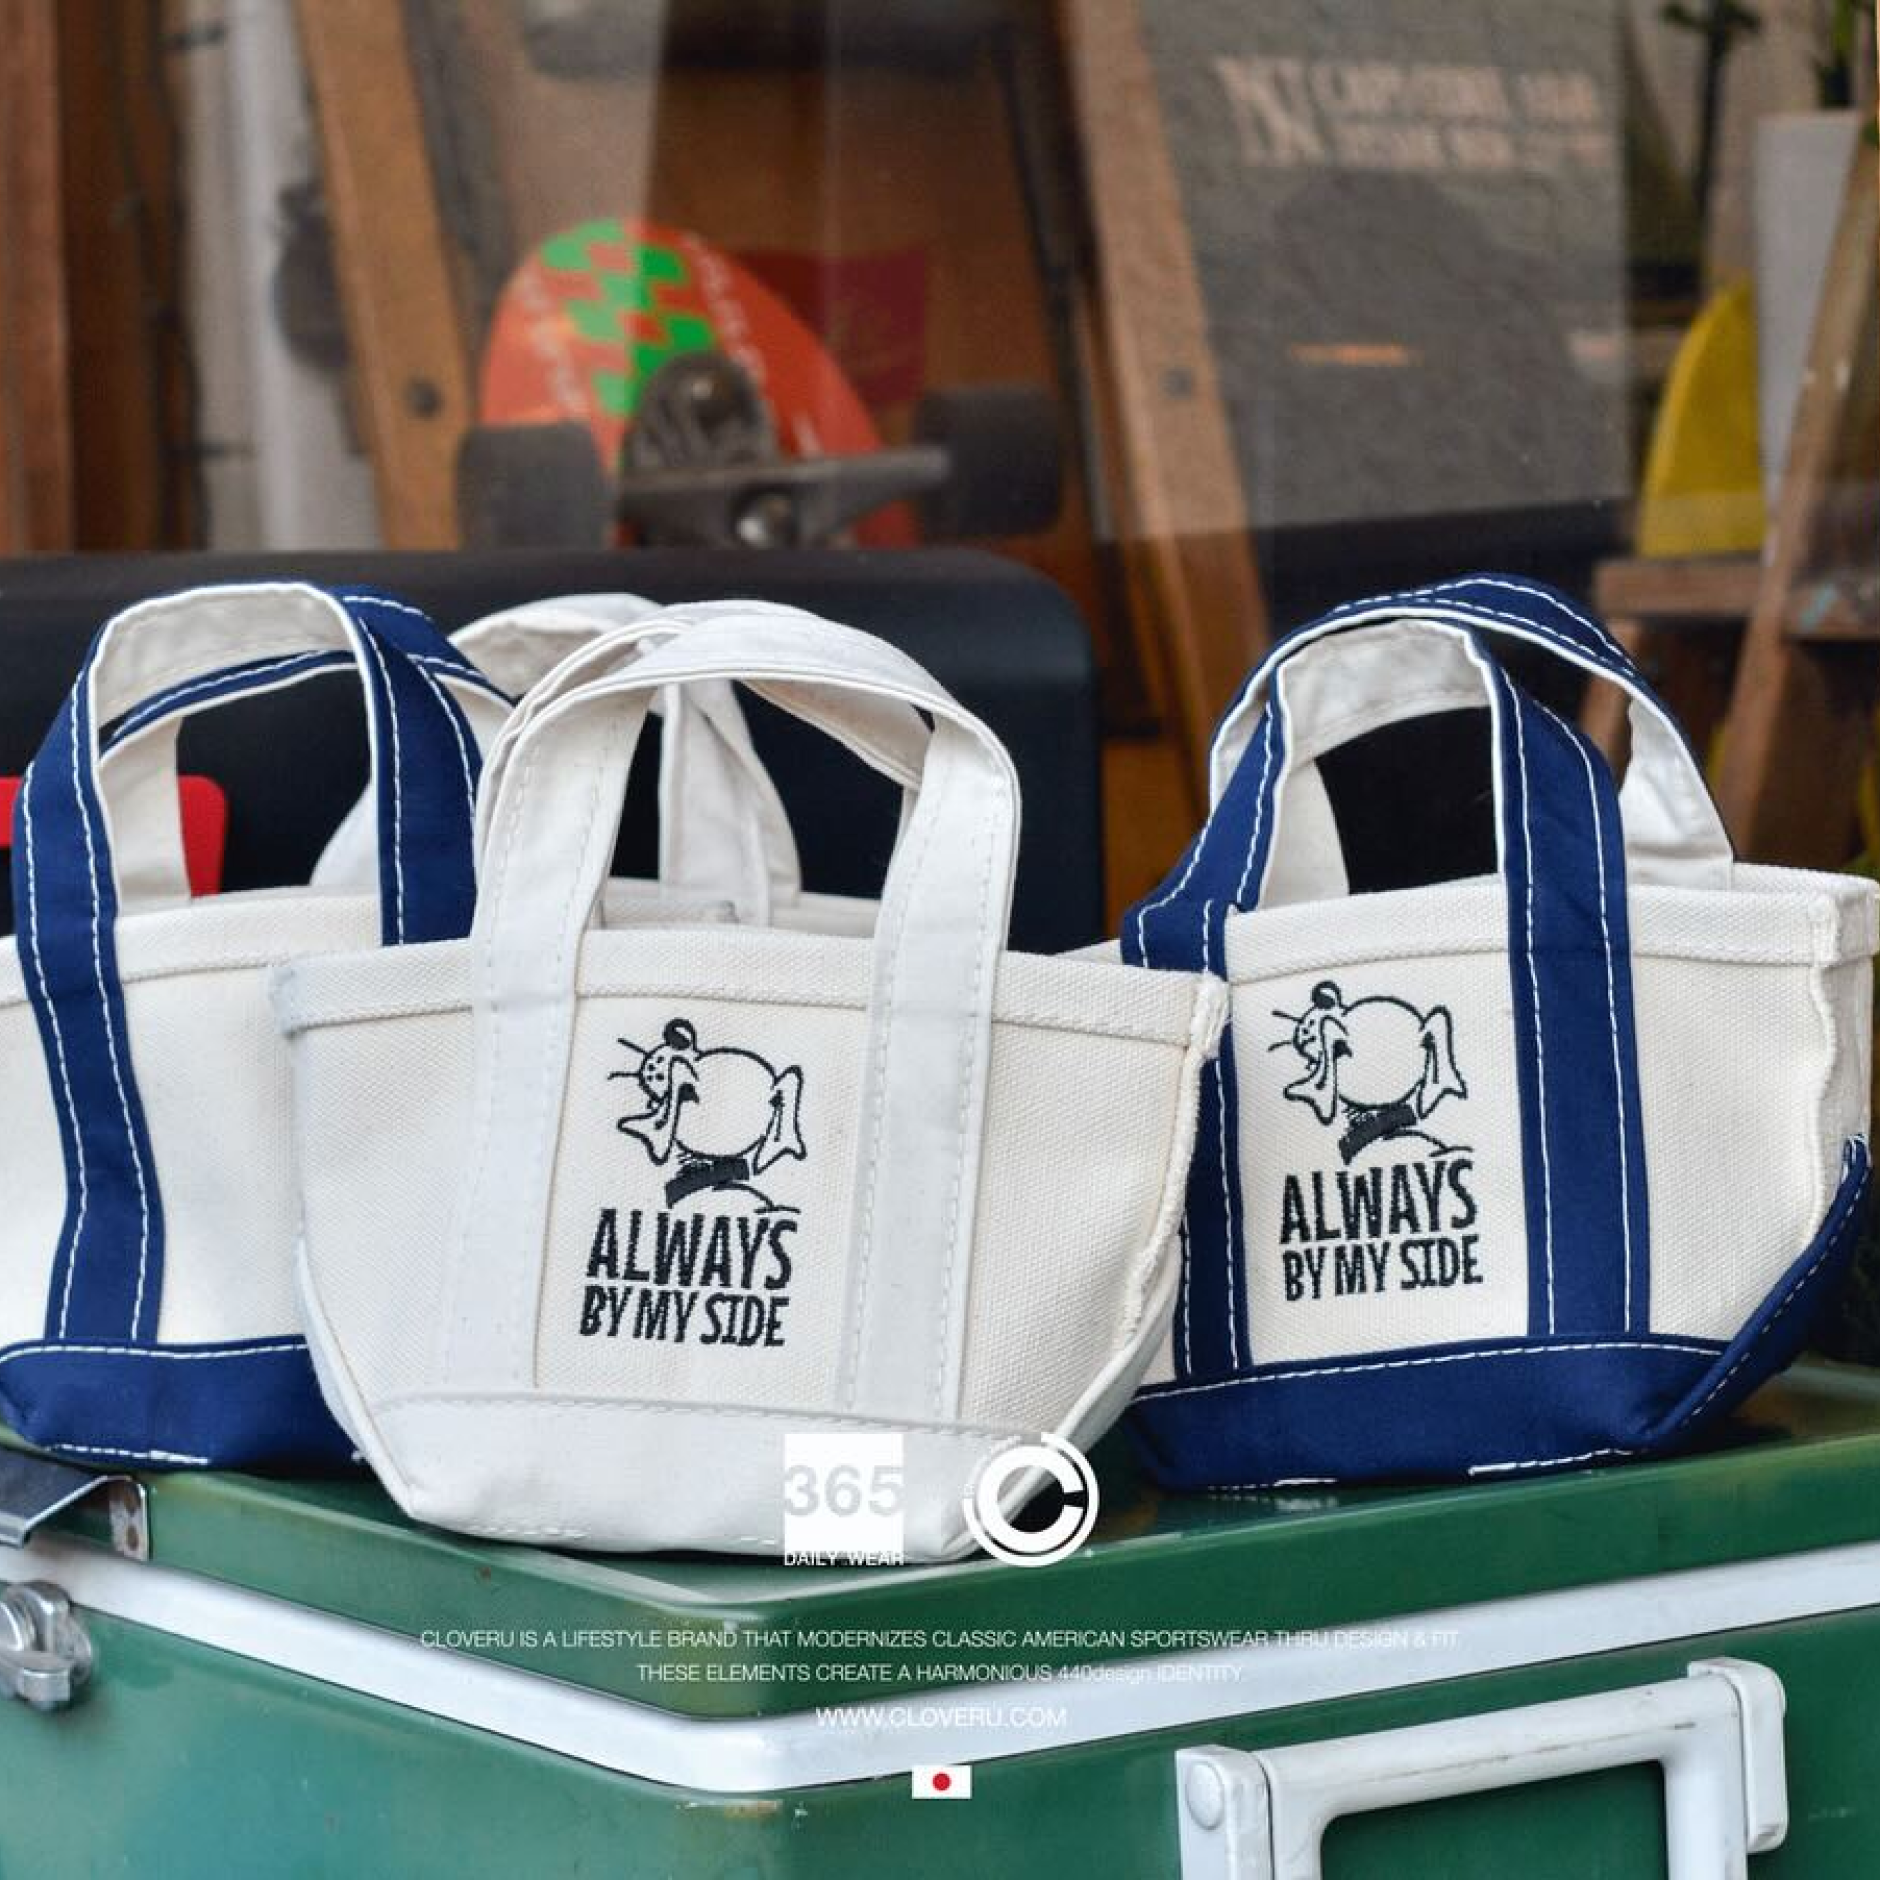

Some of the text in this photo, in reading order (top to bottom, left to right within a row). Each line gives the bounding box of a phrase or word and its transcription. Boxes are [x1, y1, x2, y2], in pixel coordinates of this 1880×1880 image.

[1280, 1158, 1478, 1245] ALWAYS
[586, 1208, 798, 1291] ALWAYS
[1282, 1233, 1483, 1302] BY MY SIDE
[579, 1285, 790, 1347] BY MY SIDE
